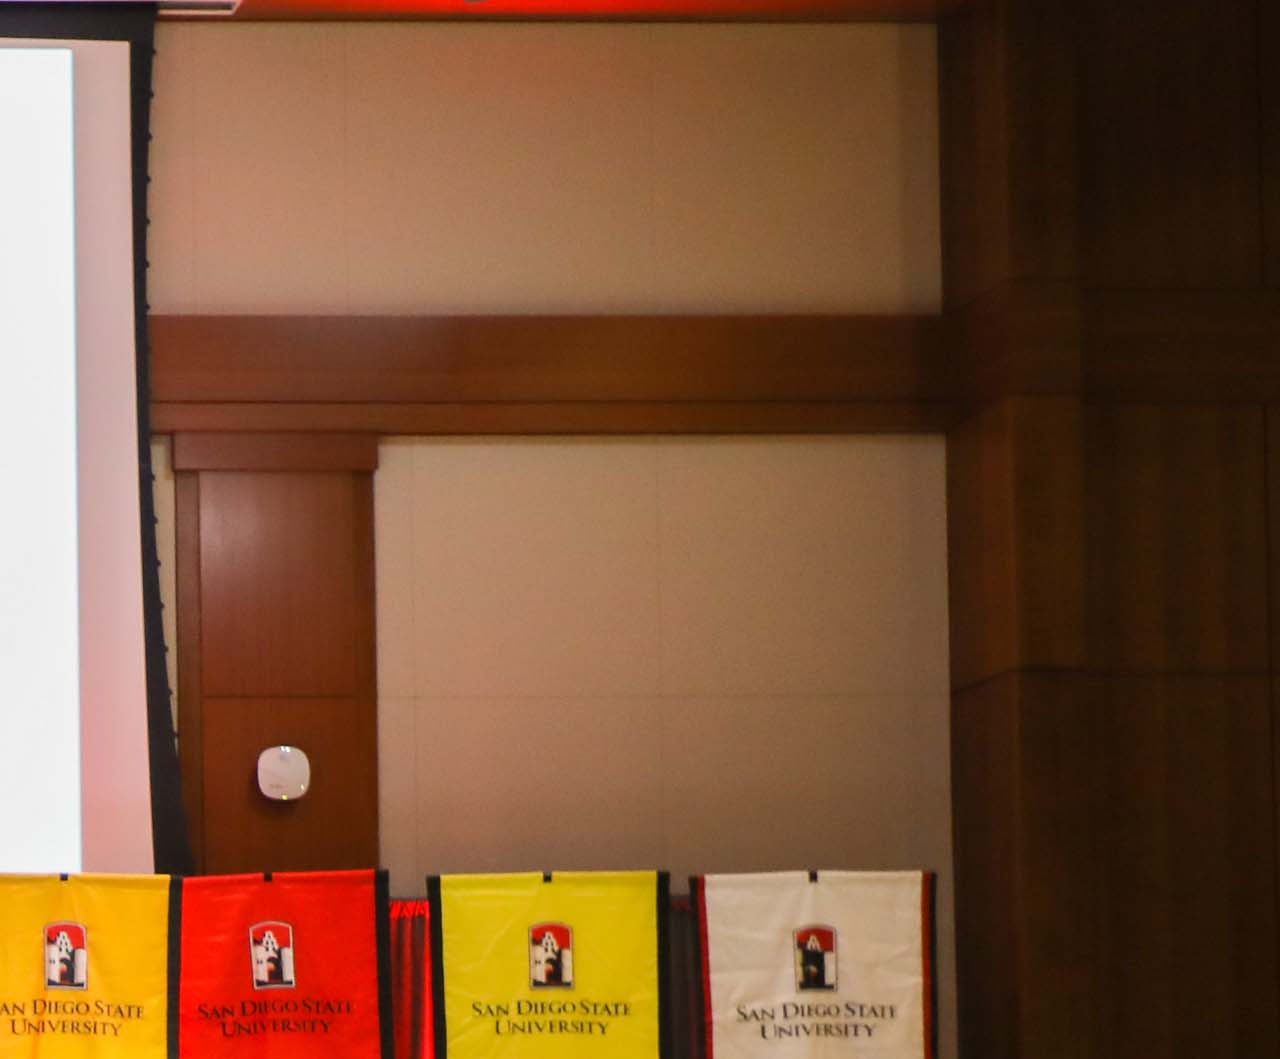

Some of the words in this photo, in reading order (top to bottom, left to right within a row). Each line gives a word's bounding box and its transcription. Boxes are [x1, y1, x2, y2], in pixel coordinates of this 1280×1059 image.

[32, 999, 90, 1017] DIEGO
[94, 1001, 145, 1019] STATE
[197, 1003, 235, 1020] SAN
[240, 1000, 298, 1018] DIEGO
[301, 999, 354, 1016] STATE
[471, 1001, 510, 1017] SAN
[516, 1000, 575, 1017] DIEGO
[579, 1001, 631, 1017] STATE
[736, 1005, 775, 1022] SAN
[782, 1003, 840, 1020] DIEGO
[844, 1003, 897, 1020] STATE
[10, 1018, 122, 1036] UNIVERSITY
[221, 1019, 333, 1038] UNIVERSITY
[494, 1019, 610, 1036] UNIVERSITY
[760, 1022, 877, 1041] UNIVERSITY
